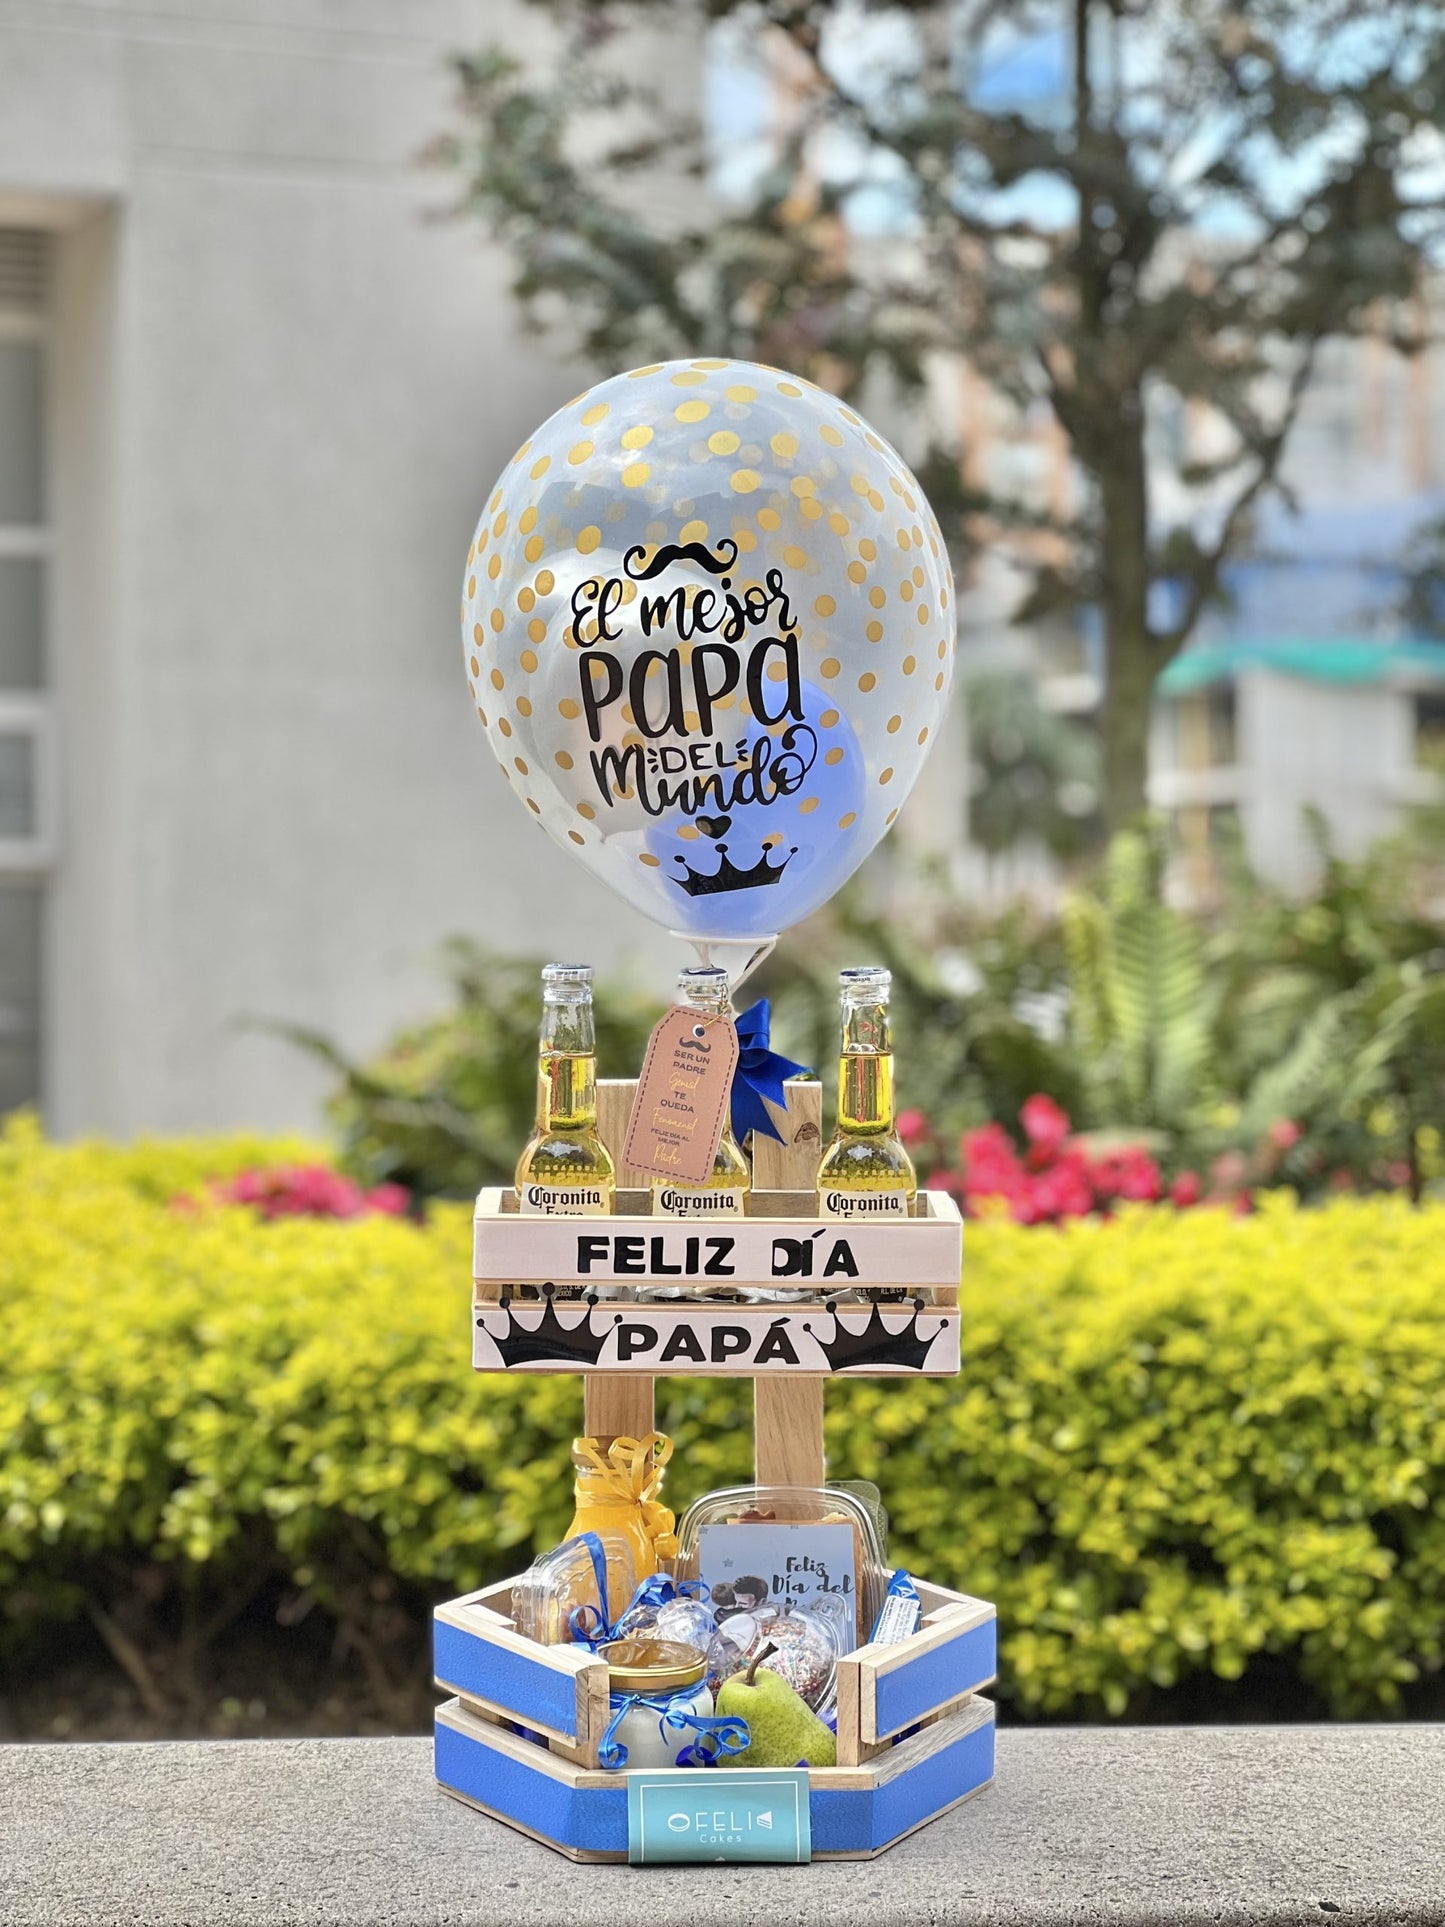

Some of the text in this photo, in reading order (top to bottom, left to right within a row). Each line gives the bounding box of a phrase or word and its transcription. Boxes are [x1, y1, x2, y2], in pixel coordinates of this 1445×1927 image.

[571, 568, 798, 648] El mejor
[590, 723, 818, 816] Mundo
[660, 743, 736, 774] DEL
[673, 1061, 707, 1075] PADRE
[674, 1049, 711, 1065] SER UN
[674, 1090, 687, 1100] TE
[660, 1099, 694, 1114] QUEDA
[657, 1137, 681, 1147] MEJOR
[528, 1186, 601, 1208] Coronita
[660, 1189, 735, 1213] Coronita
[826, 1192, 899, 1215] Coronita
[577, 1228, 860, 1278] FELIZ DÍA
[617, 1316, 801, 1364] PAPÁ
[786, 1555, 827, 1577] Feliz
[772, 1574, 855, 1595] Día del
[699, 1833, 743, 1844] Cakes
